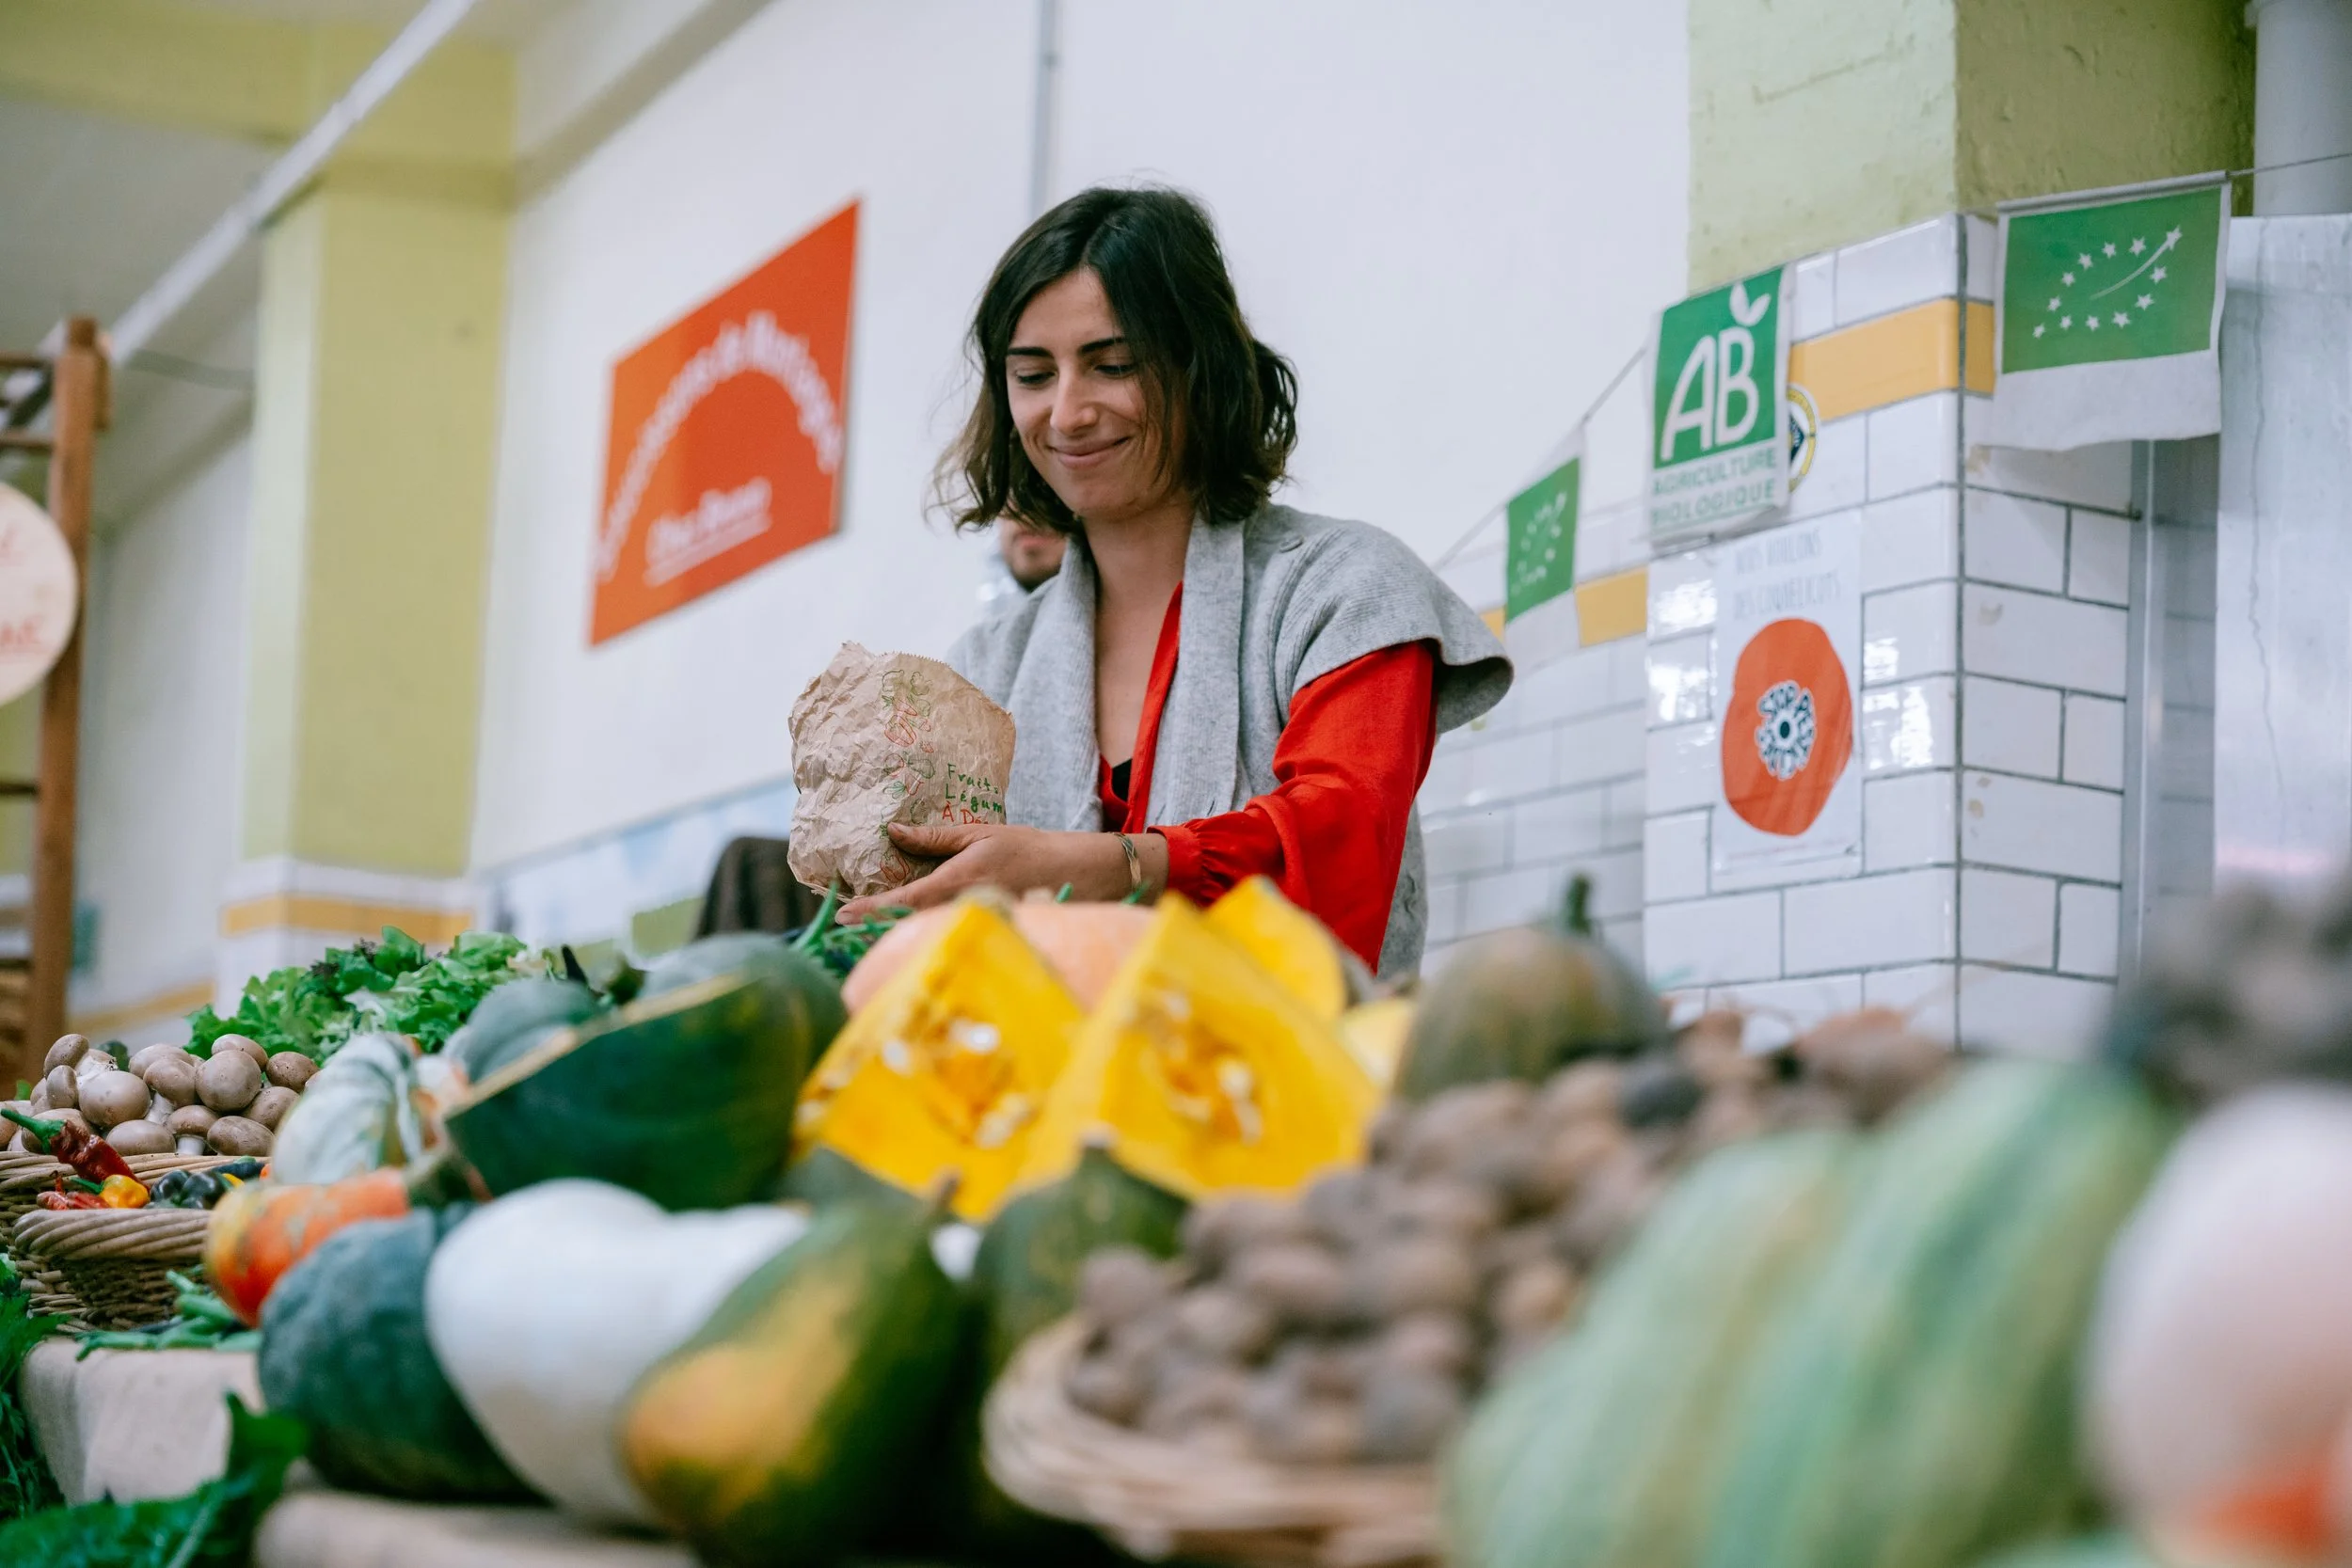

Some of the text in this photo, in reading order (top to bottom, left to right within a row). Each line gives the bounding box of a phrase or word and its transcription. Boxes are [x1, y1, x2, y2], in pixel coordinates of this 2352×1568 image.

[1660, 326, 1759, 462] AB
[1651, 446, 1777, 497] AGRICULTURE
[1650, 477, 1776, 527] BIOLOGIQUE
[945, 783, 1006, 814] Légum
